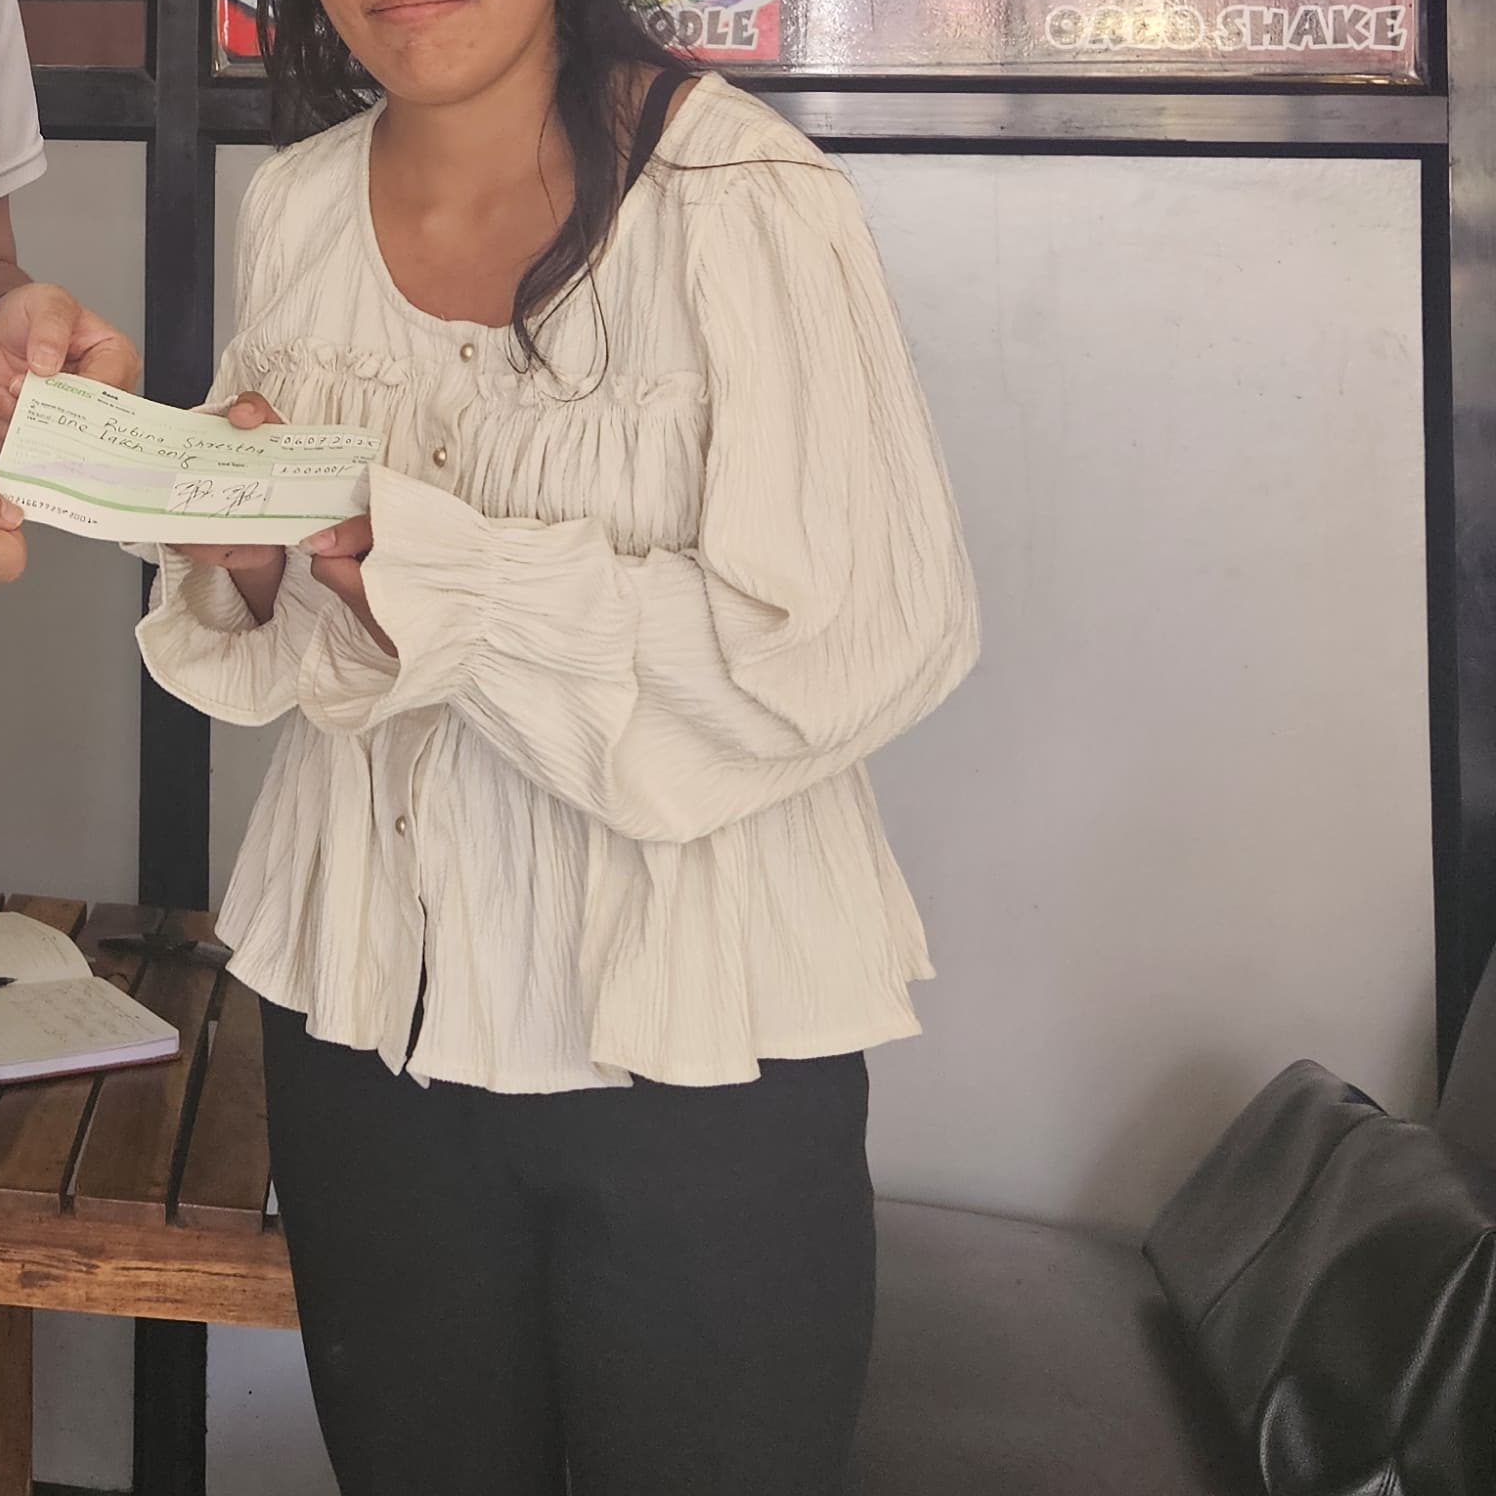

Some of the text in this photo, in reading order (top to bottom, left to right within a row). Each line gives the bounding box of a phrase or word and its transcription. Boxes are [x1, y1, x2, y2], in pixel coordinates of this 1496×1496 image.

[1216, 4, 1408, 51] SHAKE
[45, 377, 92, 400] Citizens
[57, 414, 89, 433] One
[104, 416, 165, 444] Rubina
